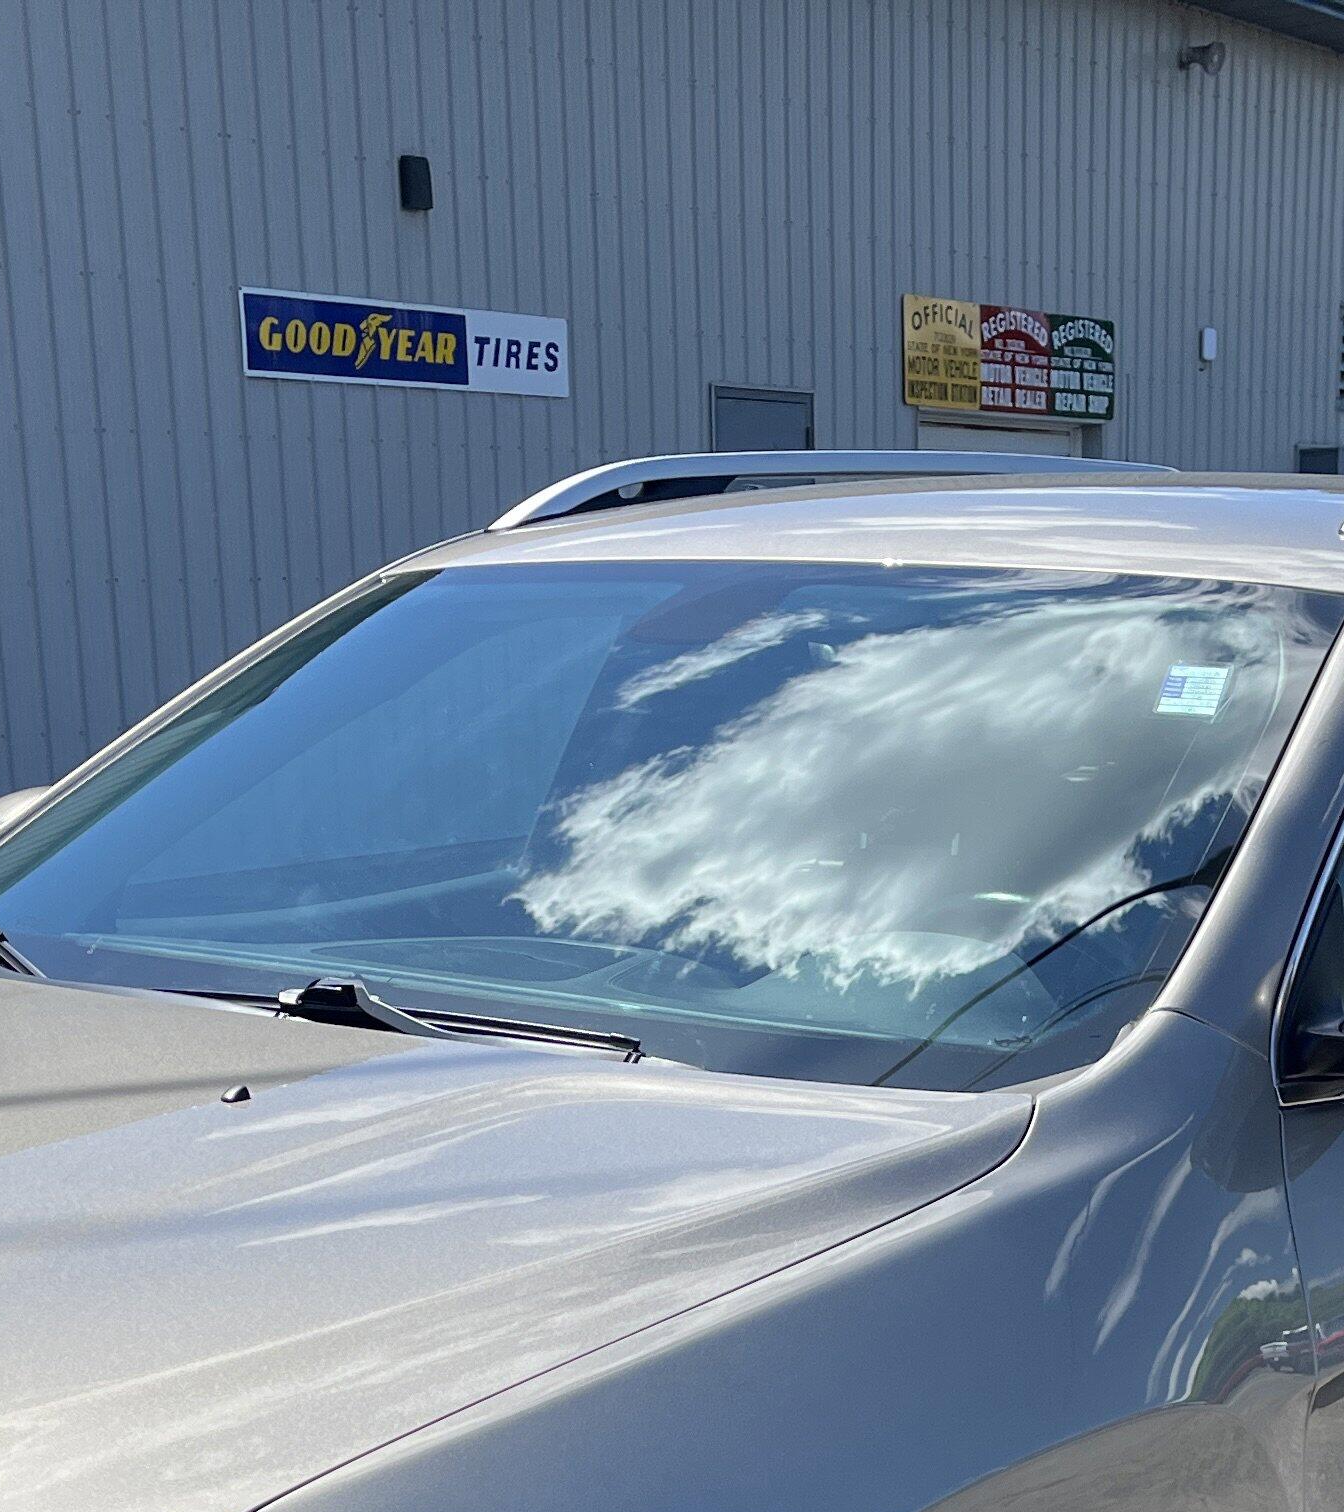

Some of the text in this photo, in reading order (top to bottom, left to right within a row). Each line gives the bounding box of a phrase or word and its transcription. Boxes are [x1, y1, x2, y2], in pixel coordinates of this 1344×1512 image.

[911, 302, 974, 340] OFFICIAL
[981, 310, 1049, 348] REGISTERED
[1051, 319, 1114, 354] REGISTERED
[259, 314, 560, 373] GOODYEAR TIRES
